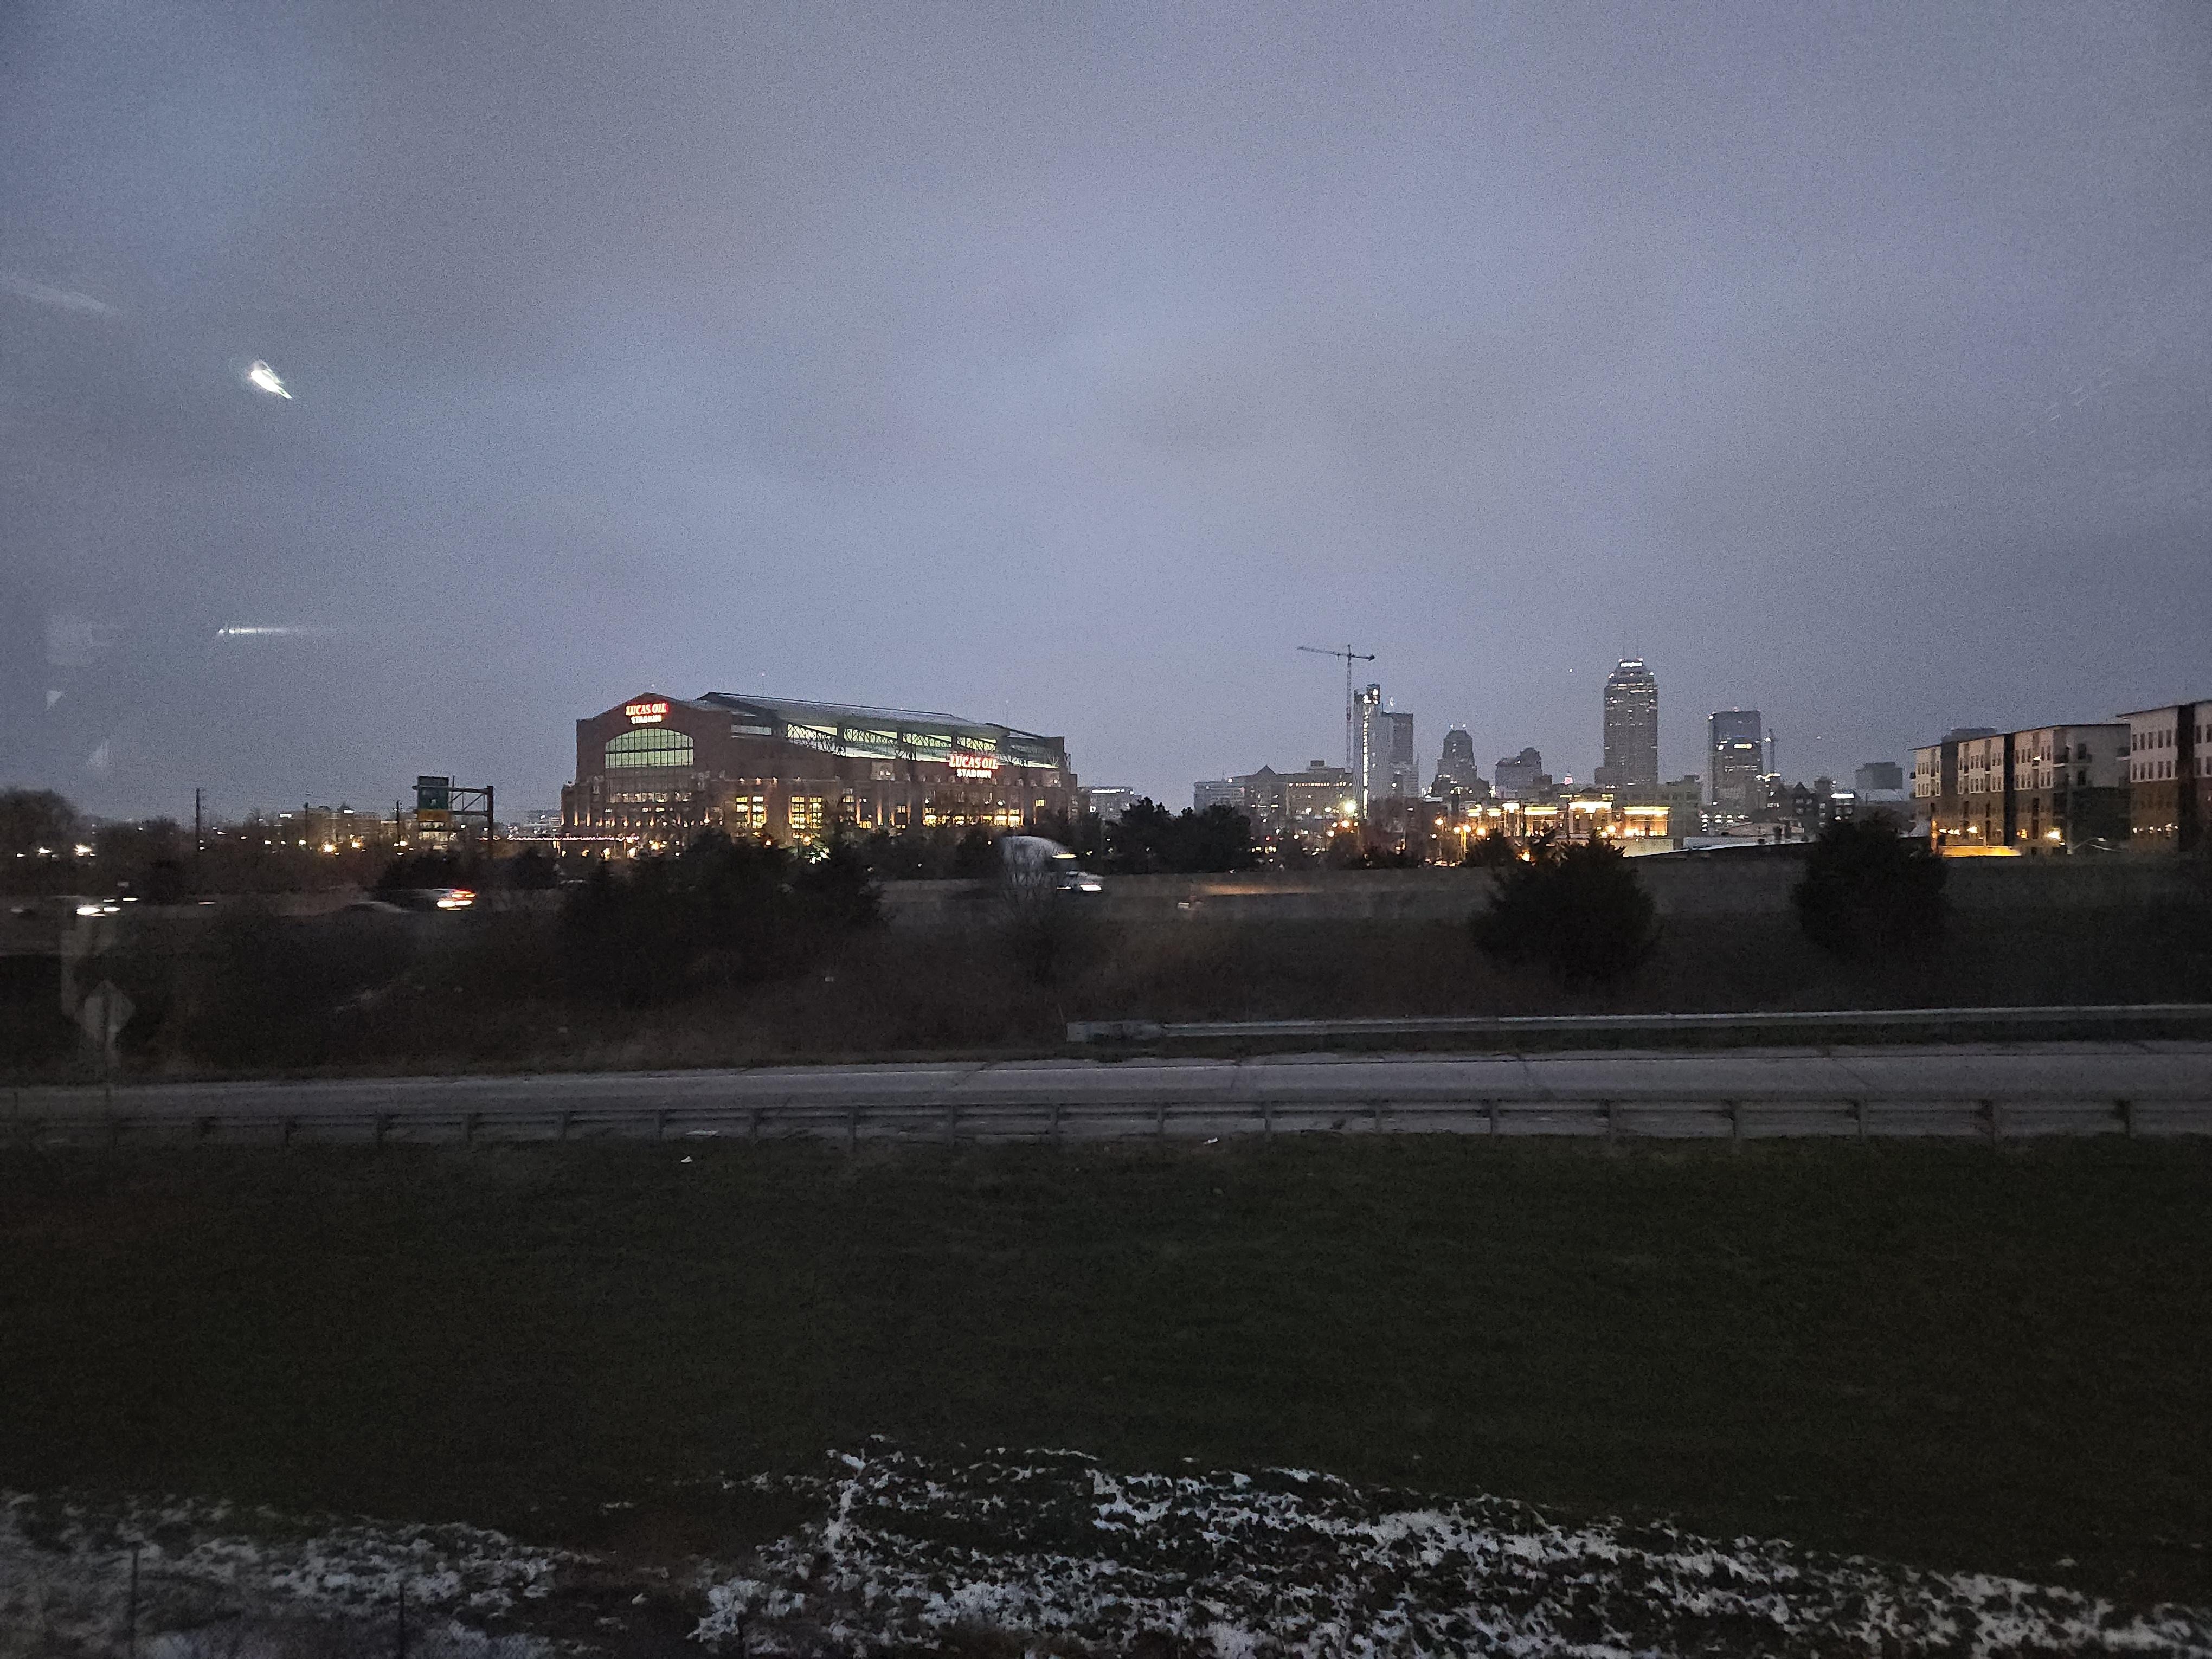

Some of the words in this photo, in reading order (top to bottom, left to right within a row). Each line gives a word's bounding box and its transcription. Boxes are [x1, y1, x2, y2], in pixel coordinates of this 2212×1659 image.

[626, 704, 651, 716] LUCAS
[652, 703, 667, 713] OIL
[949, 755, 981, 768] LUCAS
[981, 757, 999, 769] OIL
[956, 768, 992, 779] STADIUM
